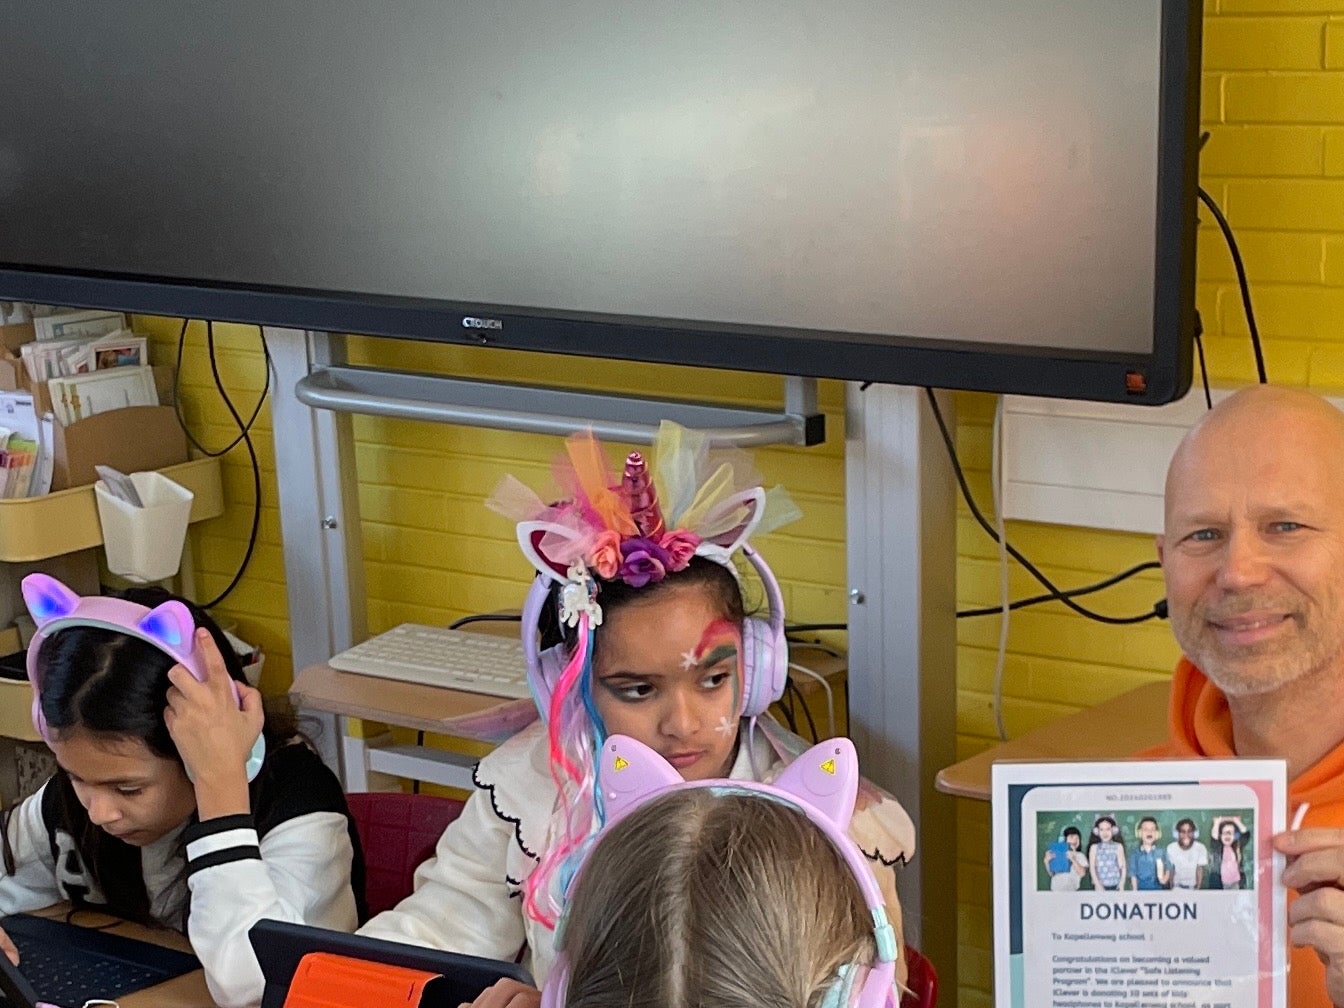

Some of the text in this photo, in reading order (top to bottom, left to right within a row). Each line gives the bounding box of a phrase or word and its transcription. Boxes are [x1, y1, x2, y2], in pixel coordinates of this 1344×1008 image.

[1080, 902, 1198, 920] DONATION
[1052, 956, 1117, 964] Congratulations
[1132, 956, 1171, 964] becoming
